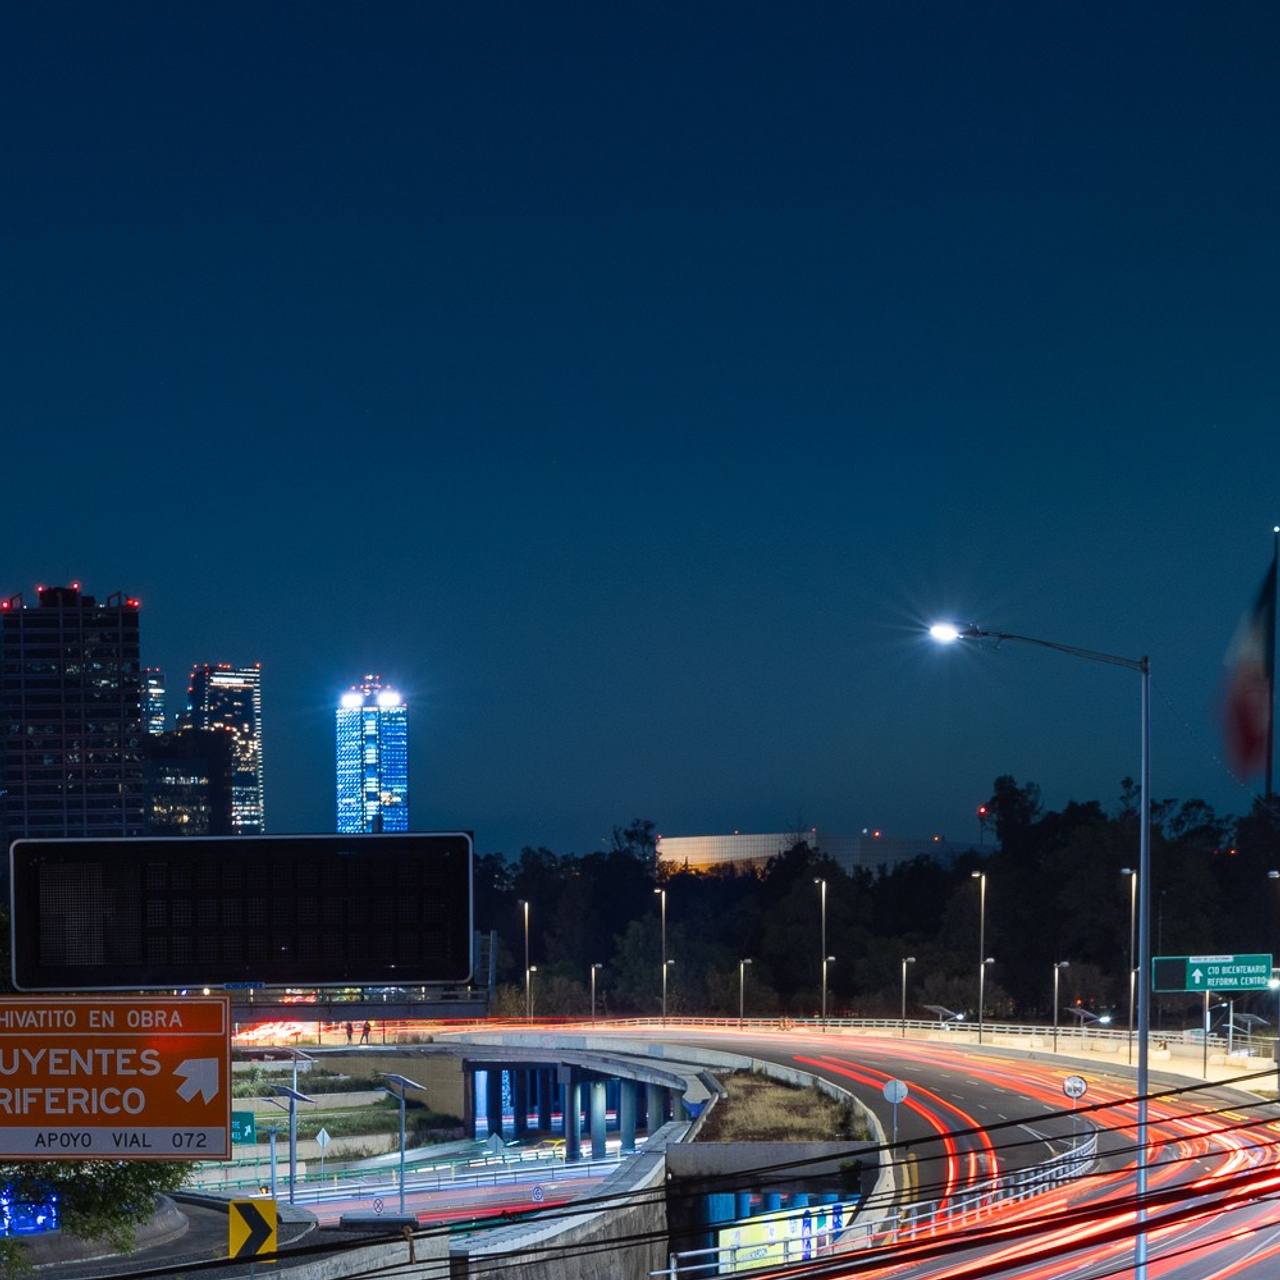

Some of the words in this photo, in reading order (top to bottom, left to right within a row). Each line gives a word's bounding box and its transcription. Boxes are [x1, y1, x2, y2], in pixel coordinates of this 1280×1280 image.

[1222, 965, 1267, 974] BICENTENARIO
[1207, 977, 1238, 986] REFORMA
[1240, 976, 1266, 986] CENTRO
[89, 1010, 115, 1028] EN
[127, 1010, 183, 1028] OBRA
[34, 1132, 93, 1149] APOYO
[113, 1132, 152, 1148] VIAL
[171, 1132, 208, 1148] 072
